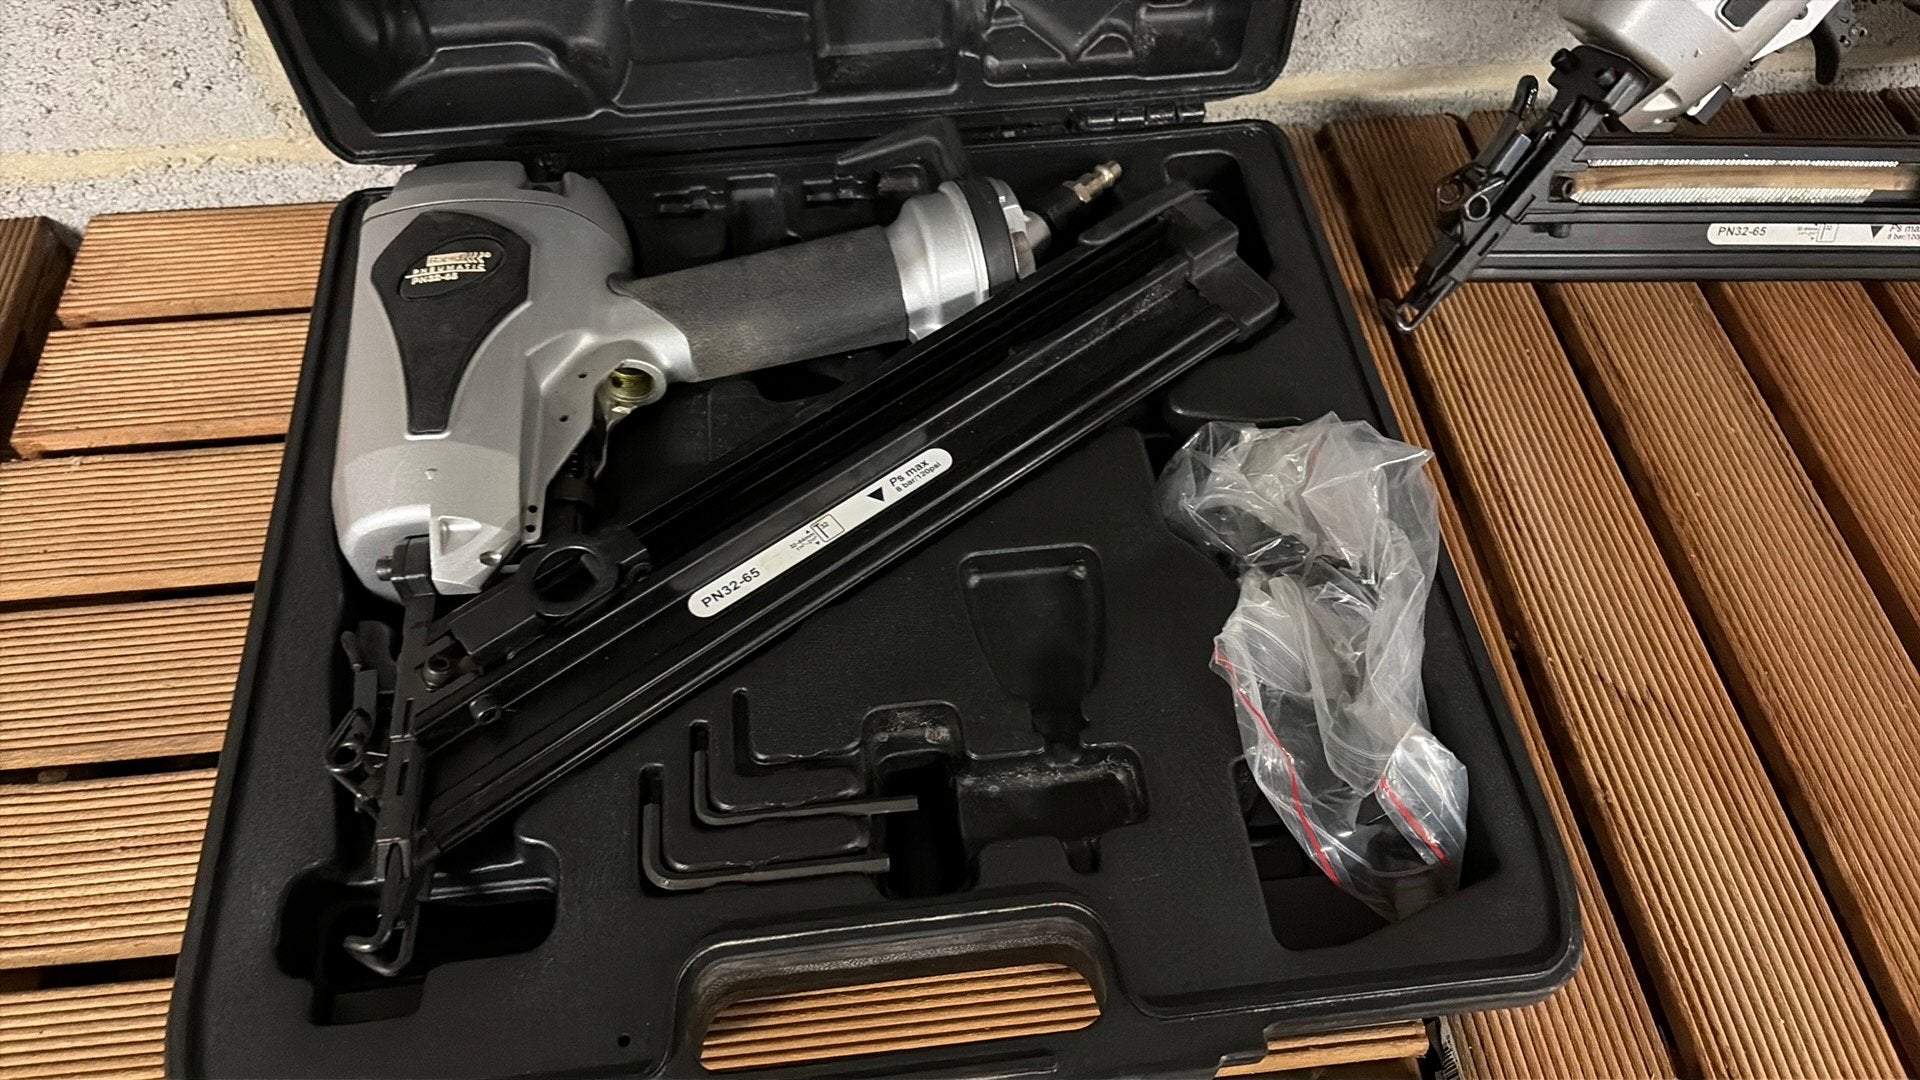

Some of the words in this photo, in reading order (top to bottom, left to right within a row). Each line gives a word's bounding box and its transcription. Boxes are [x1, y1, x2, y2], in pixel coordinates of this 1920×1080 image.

[1717, 226, 1767, 236] PN32-65
[412, 263, 486, 275] PNEUMATIC
[889, 475, 905, 487] Ps
[905, 460, 929, 477] max
[901, 461, 942, 489] bar/120psi
[820, 521, 830, 529] 32
[700, 567, 761, 608] PN32-65
